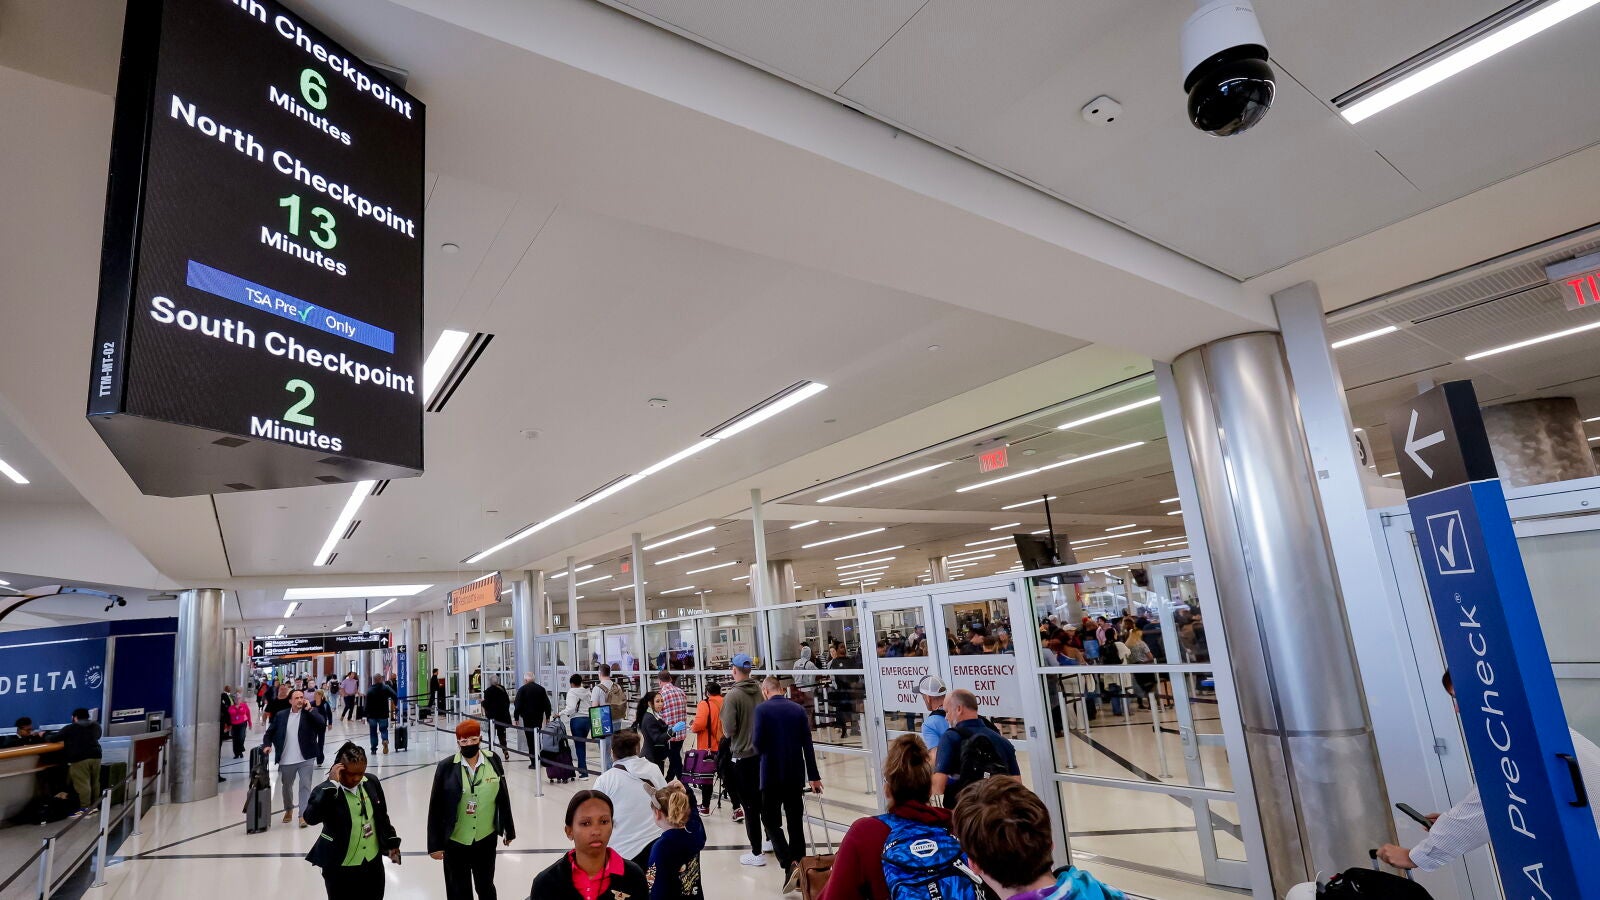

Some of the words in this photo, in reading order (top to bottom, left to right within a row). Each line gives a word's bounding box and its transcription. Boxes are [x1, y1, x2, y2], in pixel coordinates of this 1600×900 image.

[232, 0, 267, 23] in
[275, 15, 412, 119] Checkpoint
[300, 68, 328, 110] 6
[269, 85, 352, 145] Minutes
[170, 94, 264, 162] North
[272, 150, 415, 238] Checkpoint
[279, 193, 338, 250] 13
[260, 225, 347, 276] Minutes
[245, 287, 272, 307] TSA
[325, 315, 356, 337] Only
[99, 341, 115, 397] TTM-MT-02
[150, 296, 255, 349] South
[264, 331, 414, 394] Checkpoint
[283, 378, 315, 426] 2
[251, 416, 343, 451] Minutes
[0, 670, 77, 695] DELTA
[881, 666, 929, 676] EMERGENCY
[897, 680, 914, 690] EXIT
[953, 664, 1015, 676] EMERGENCY
[974, 680, 996, 691] EXIT
[897, 694, 918, 703] ONLY
